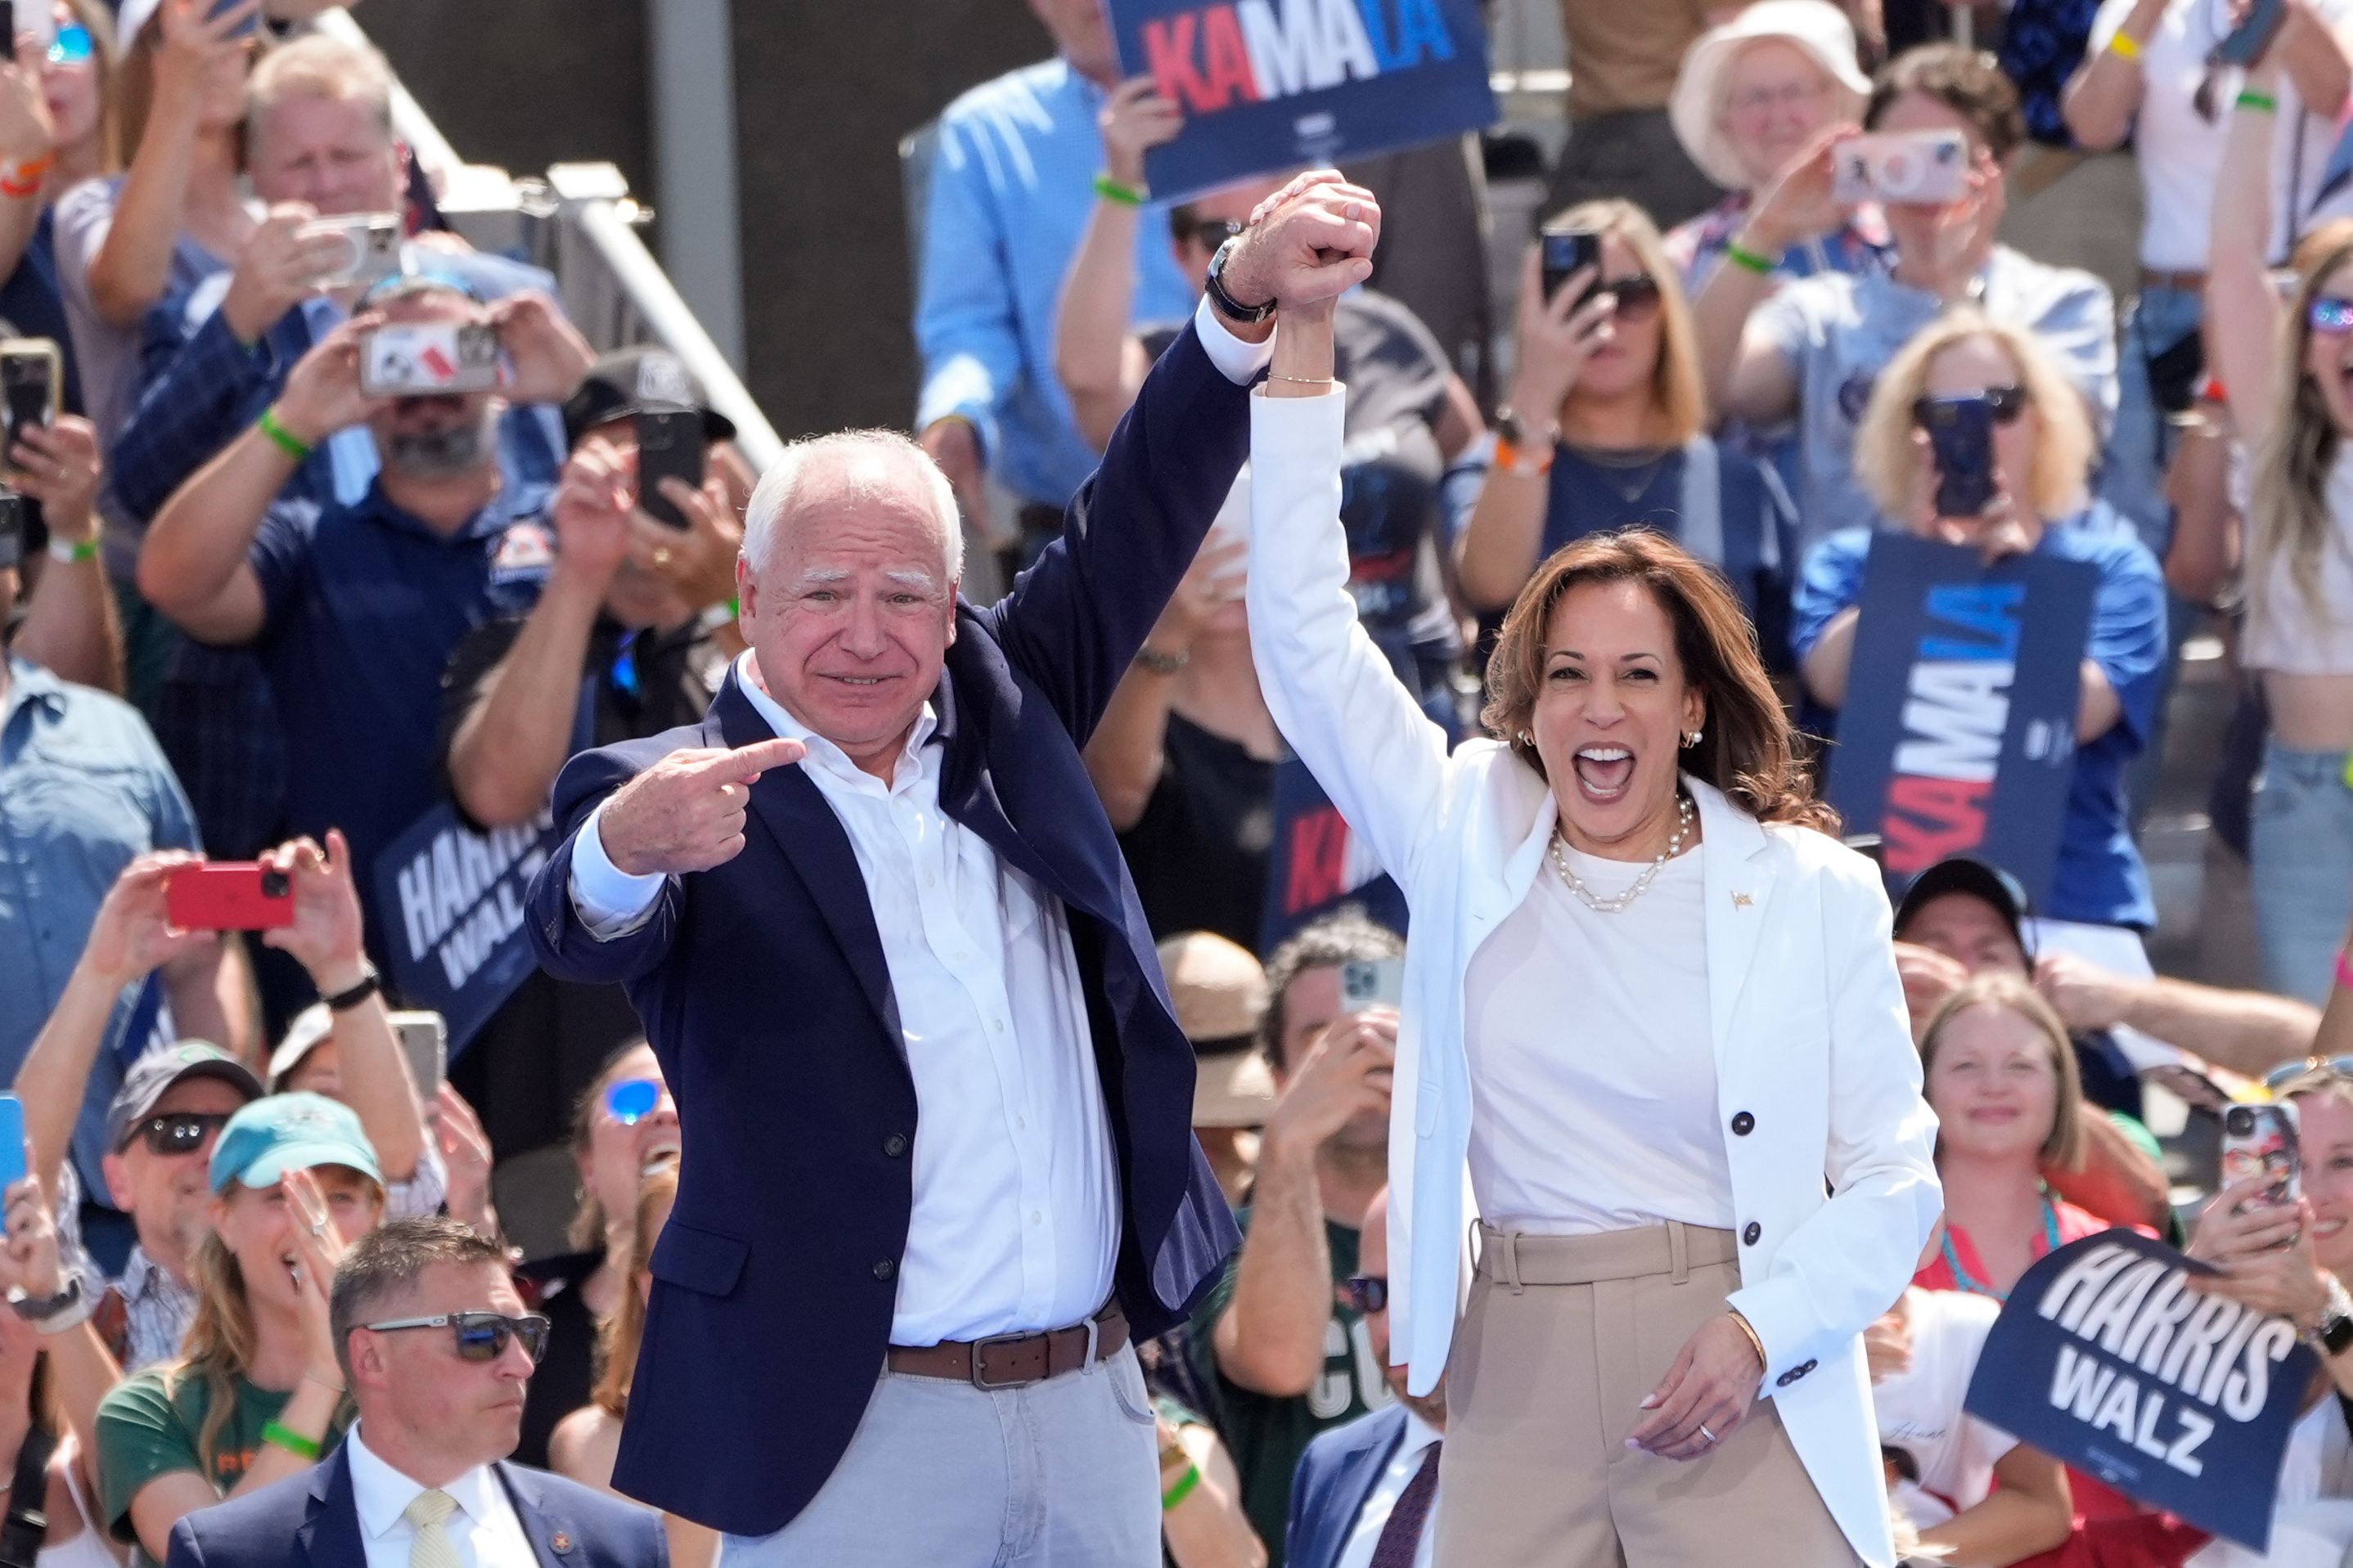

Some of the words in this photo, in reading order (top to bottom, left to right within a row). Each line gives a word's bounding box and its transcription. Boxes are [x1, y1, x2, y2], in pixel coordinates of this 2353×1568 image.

[1144, 0, 1458, 115] KAMALA
[1883, 582, 2027, 874] KAMALA
[2038, 1241, 2298, 1423] HARRIS
[2049, 1341, 2216, 1479] WALZ
